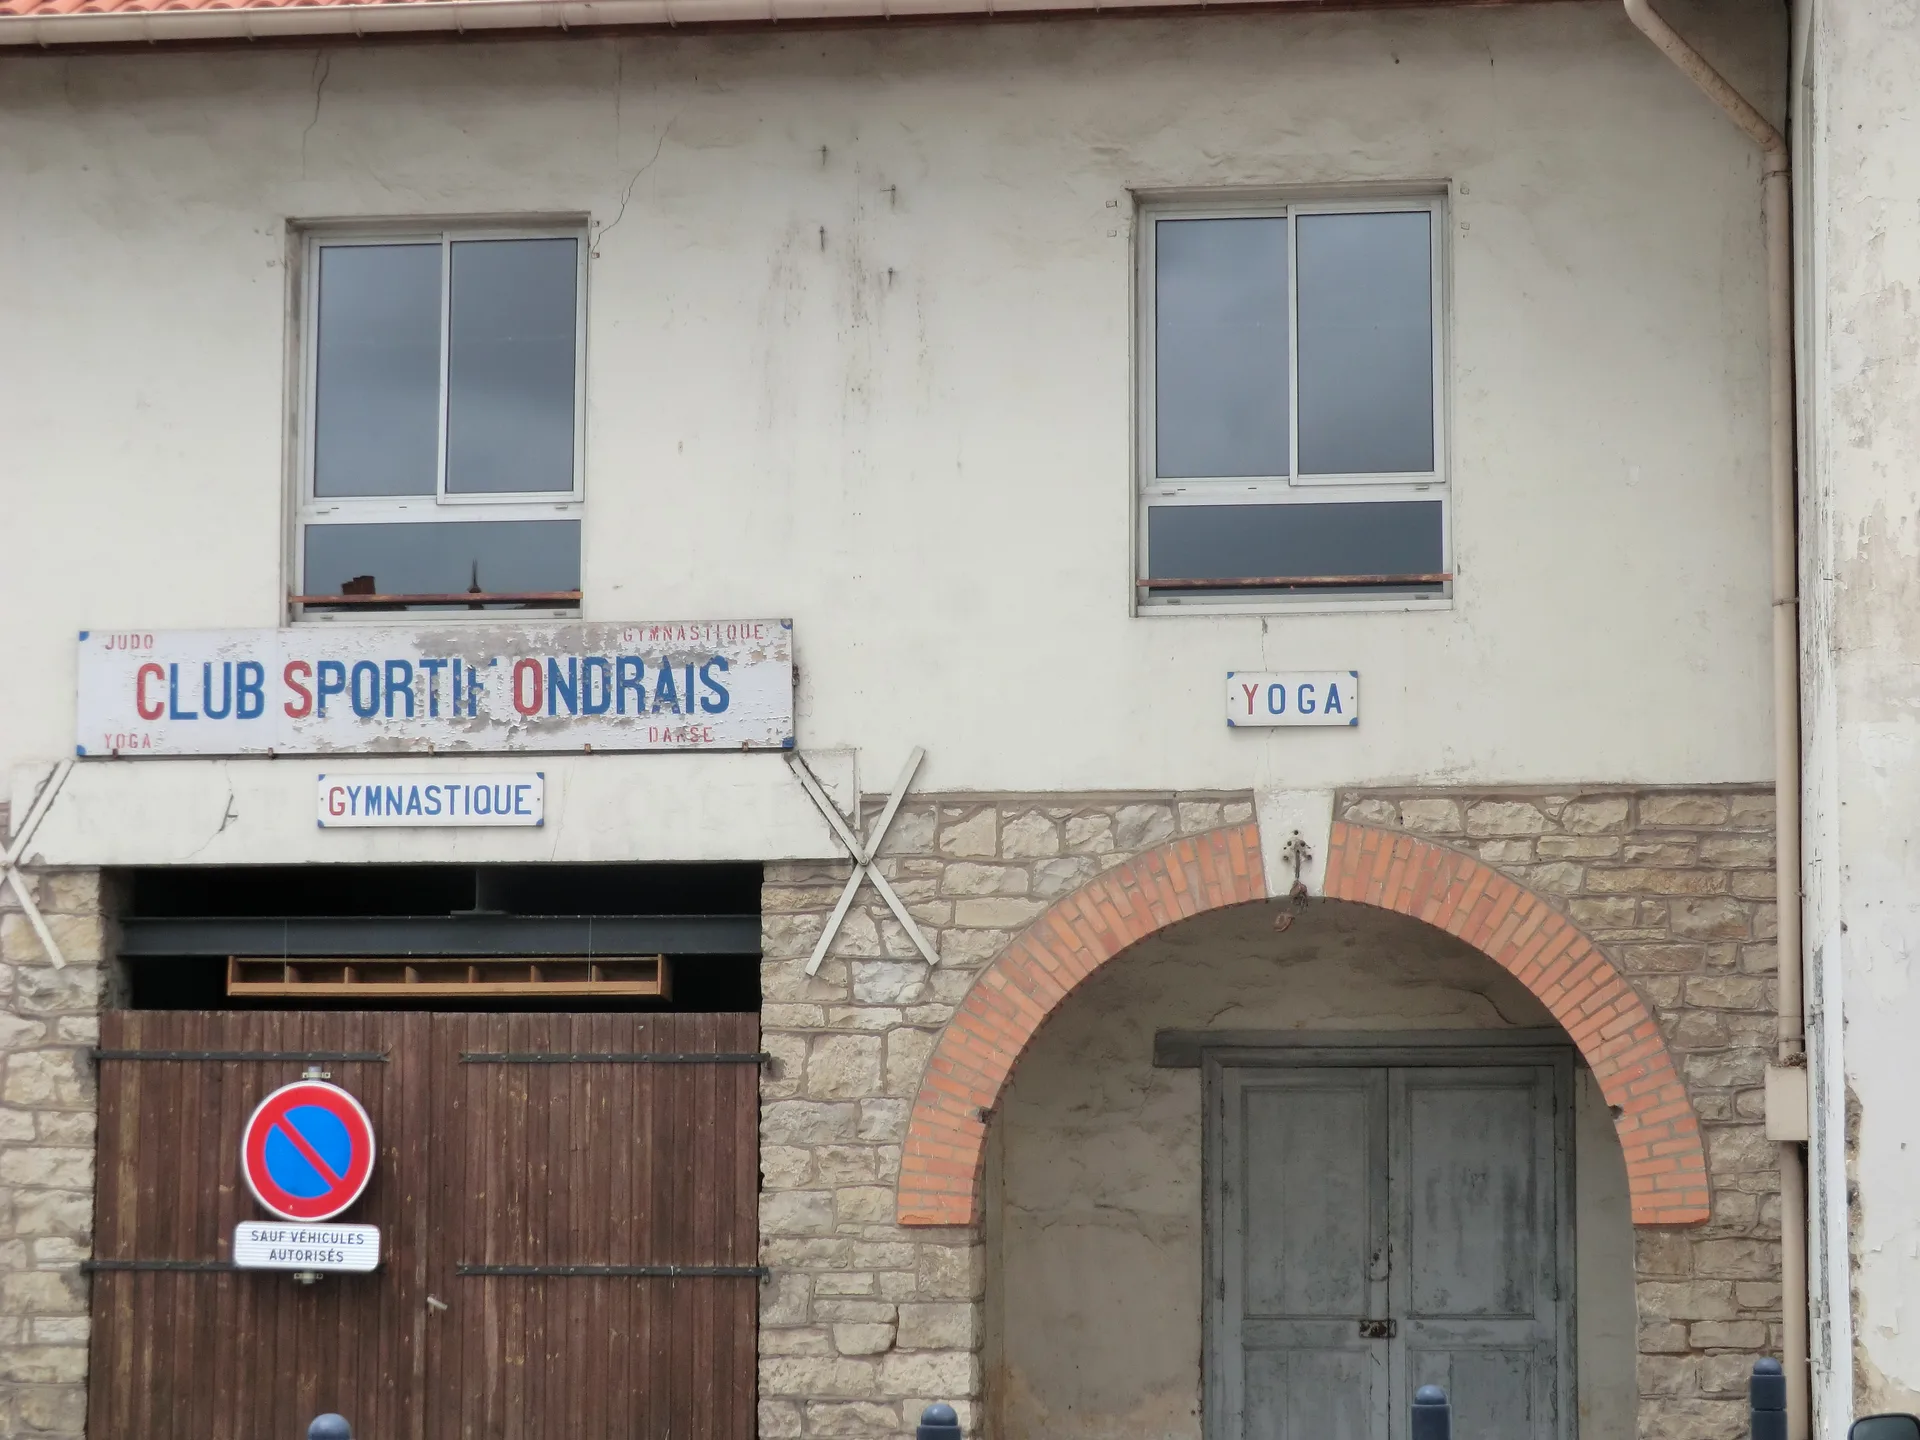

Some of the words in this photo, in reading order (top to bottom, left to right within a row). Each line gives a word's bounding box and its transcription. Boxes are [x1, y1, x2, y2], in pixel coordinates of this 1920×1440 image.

[623, 624, 764, 642] GYMNASTIQUE
[105, 634, 154, 650] JUDO
[136, 661, 265, 720] CLUB
[513, 656, 730, 716] ONDRAIS
[1242, 683, 1343, 715] YOGA
[104, 733, 151, 749] YOGA
[329, 784, 532, 816] GYMNASTIQUE
[251, 1230, 286, 1242] SAUF
[291, 1229, 365, 1245] VÉHICULES
[269, 1248, 344, 1262] AUTORISÉS
